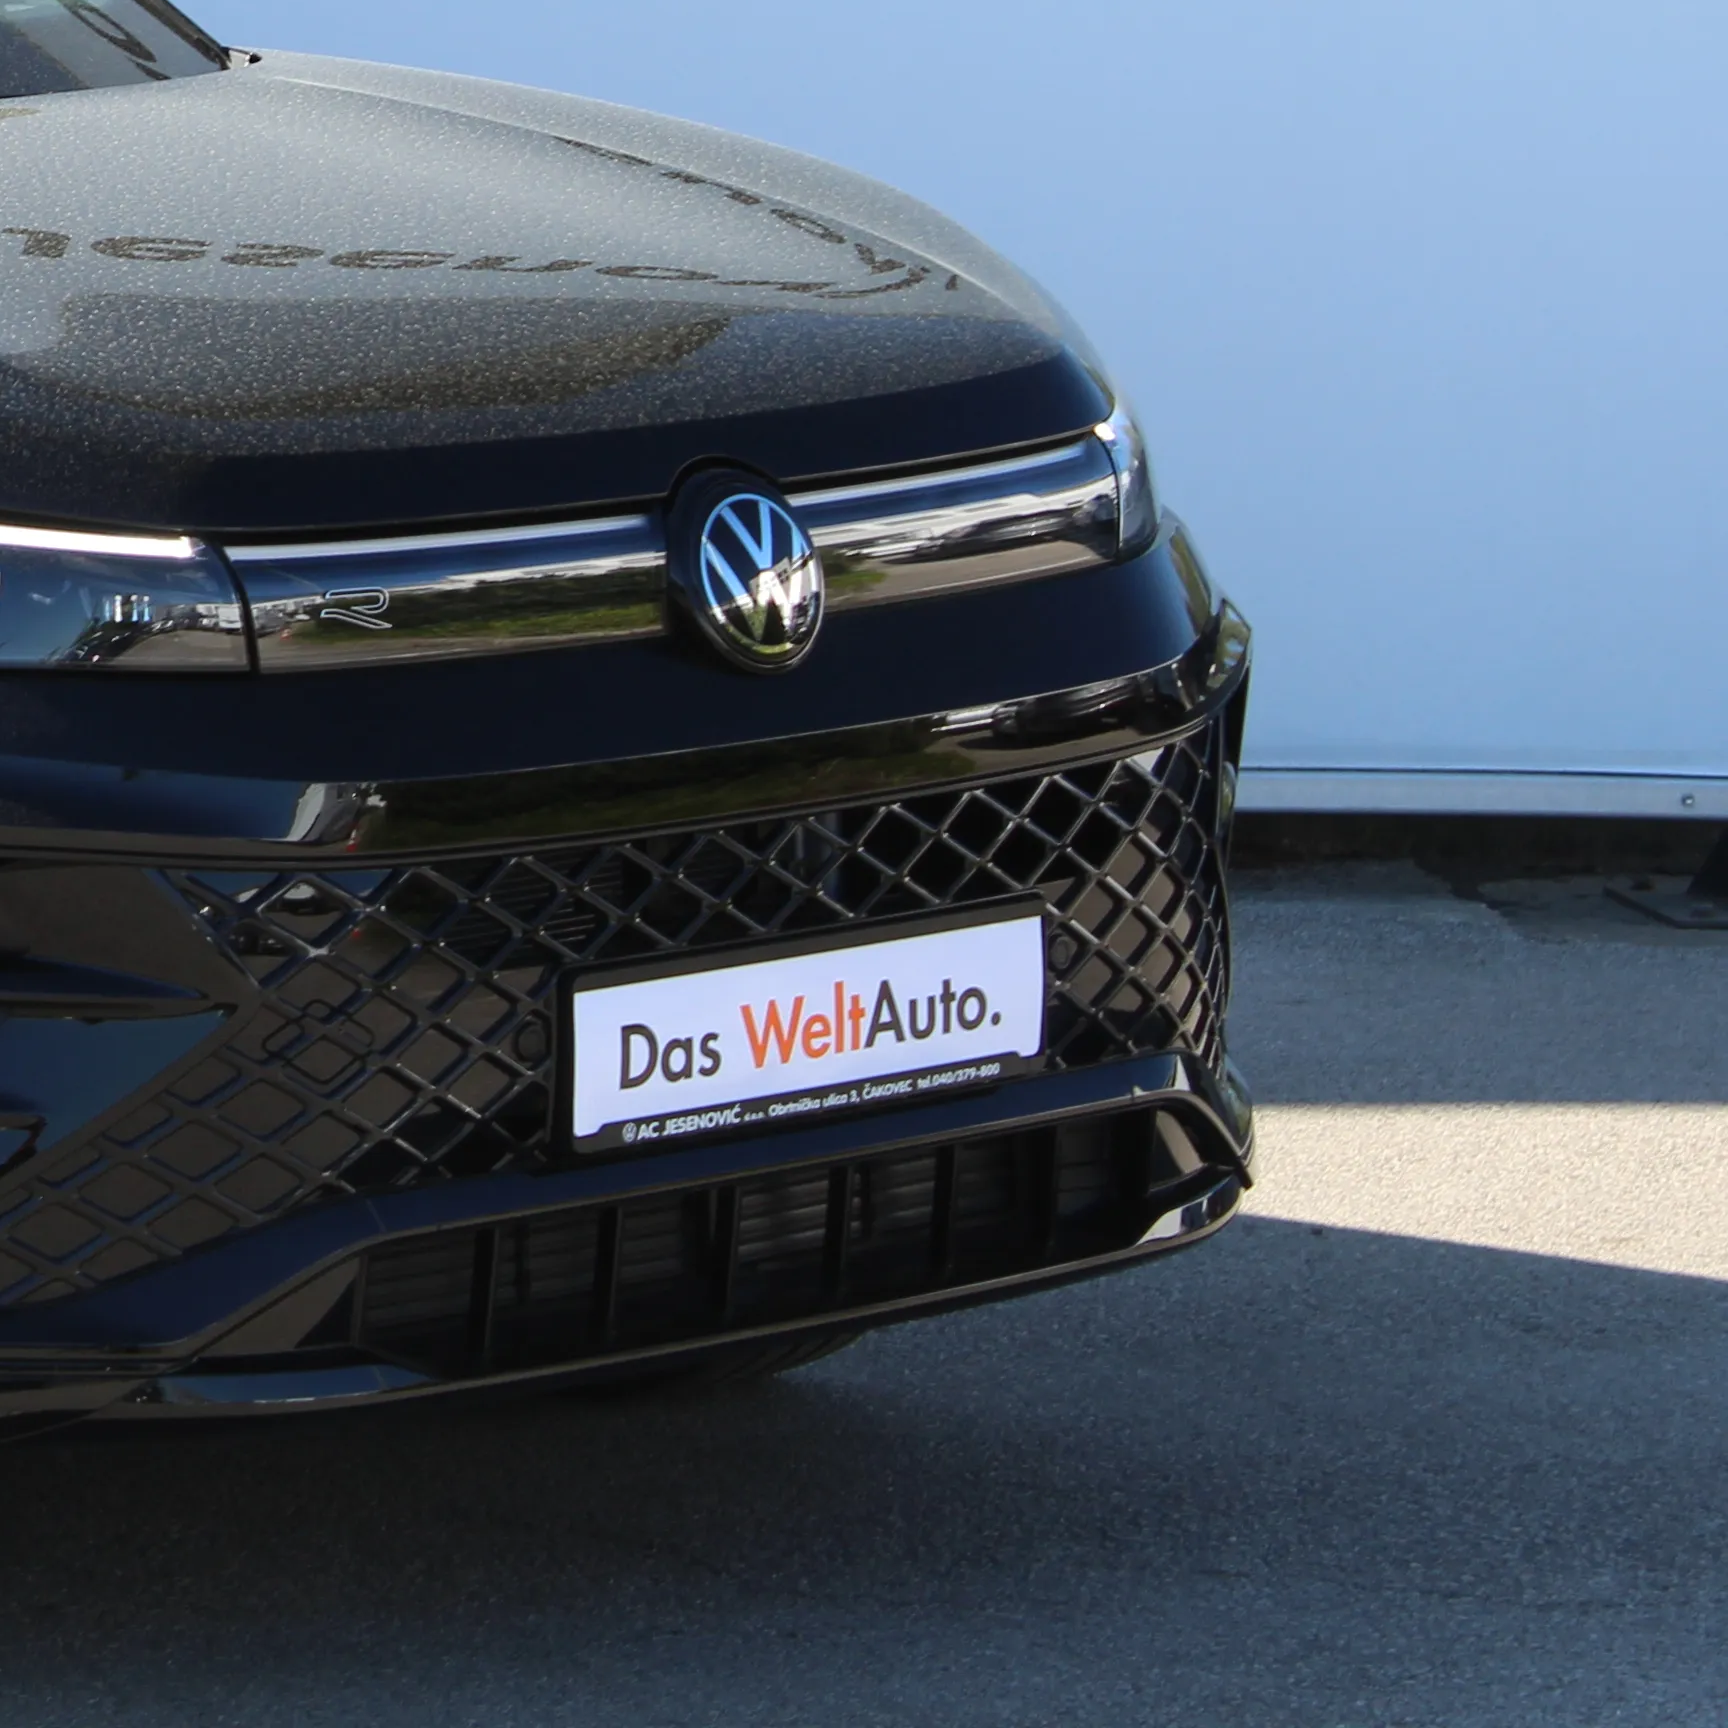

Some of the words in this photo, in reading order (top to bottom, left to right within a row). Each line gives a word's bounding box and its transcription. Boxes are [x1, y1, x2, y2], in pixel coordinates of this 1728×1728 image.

[619, 1024, 722, 1090] Das
[740, 979, 1002, 1069] WeltAuto.
[637, 1122, 660, 1141] AC
[662, 1103, 742, 1137] JESENOVIĆ
[862, 1082, 914, 1101] ČAKOVEC
